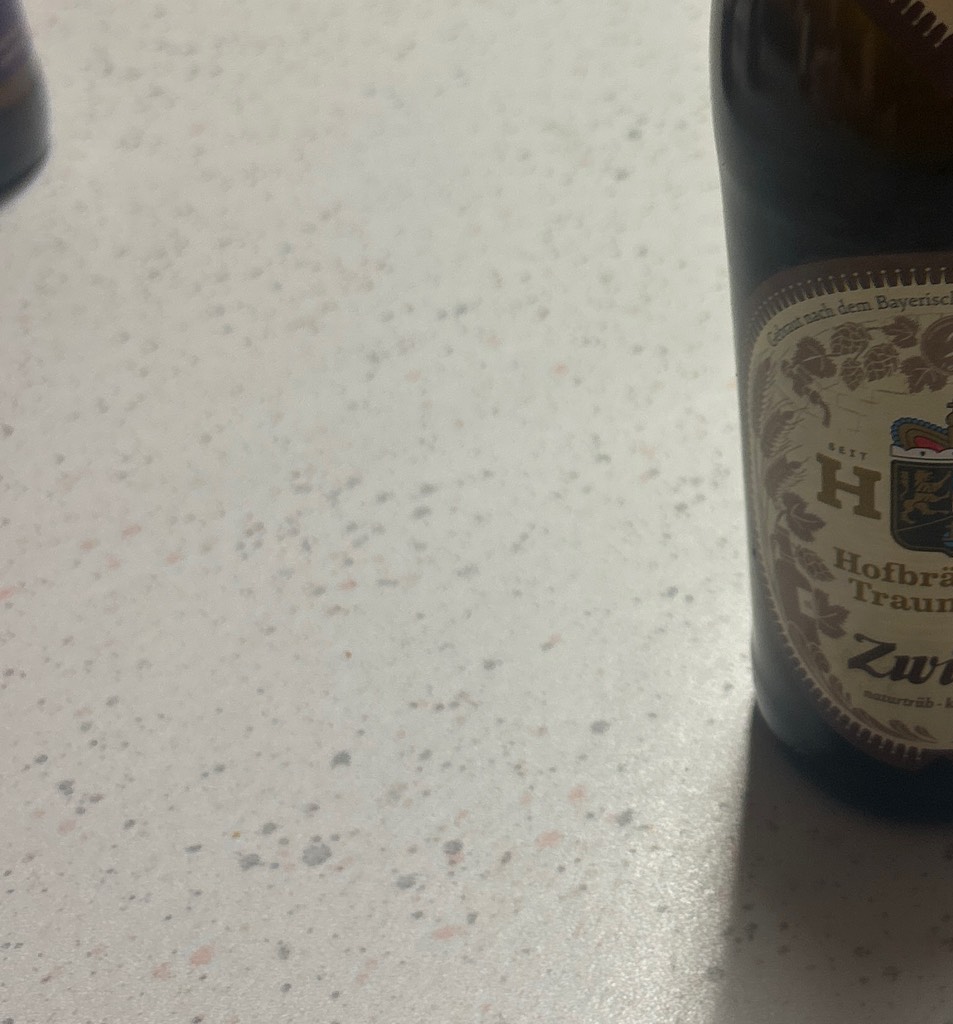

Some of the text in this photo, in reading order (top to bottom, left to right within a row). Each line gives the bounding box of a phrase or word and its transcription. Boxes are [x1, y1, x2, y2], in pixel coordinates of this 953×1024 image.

[838, 298, 873, 315] dem
[828, 441, 868, 461] SEIT
[816, 451, 883, 520] H
[863, 689, 935, 709] naturtrüb
